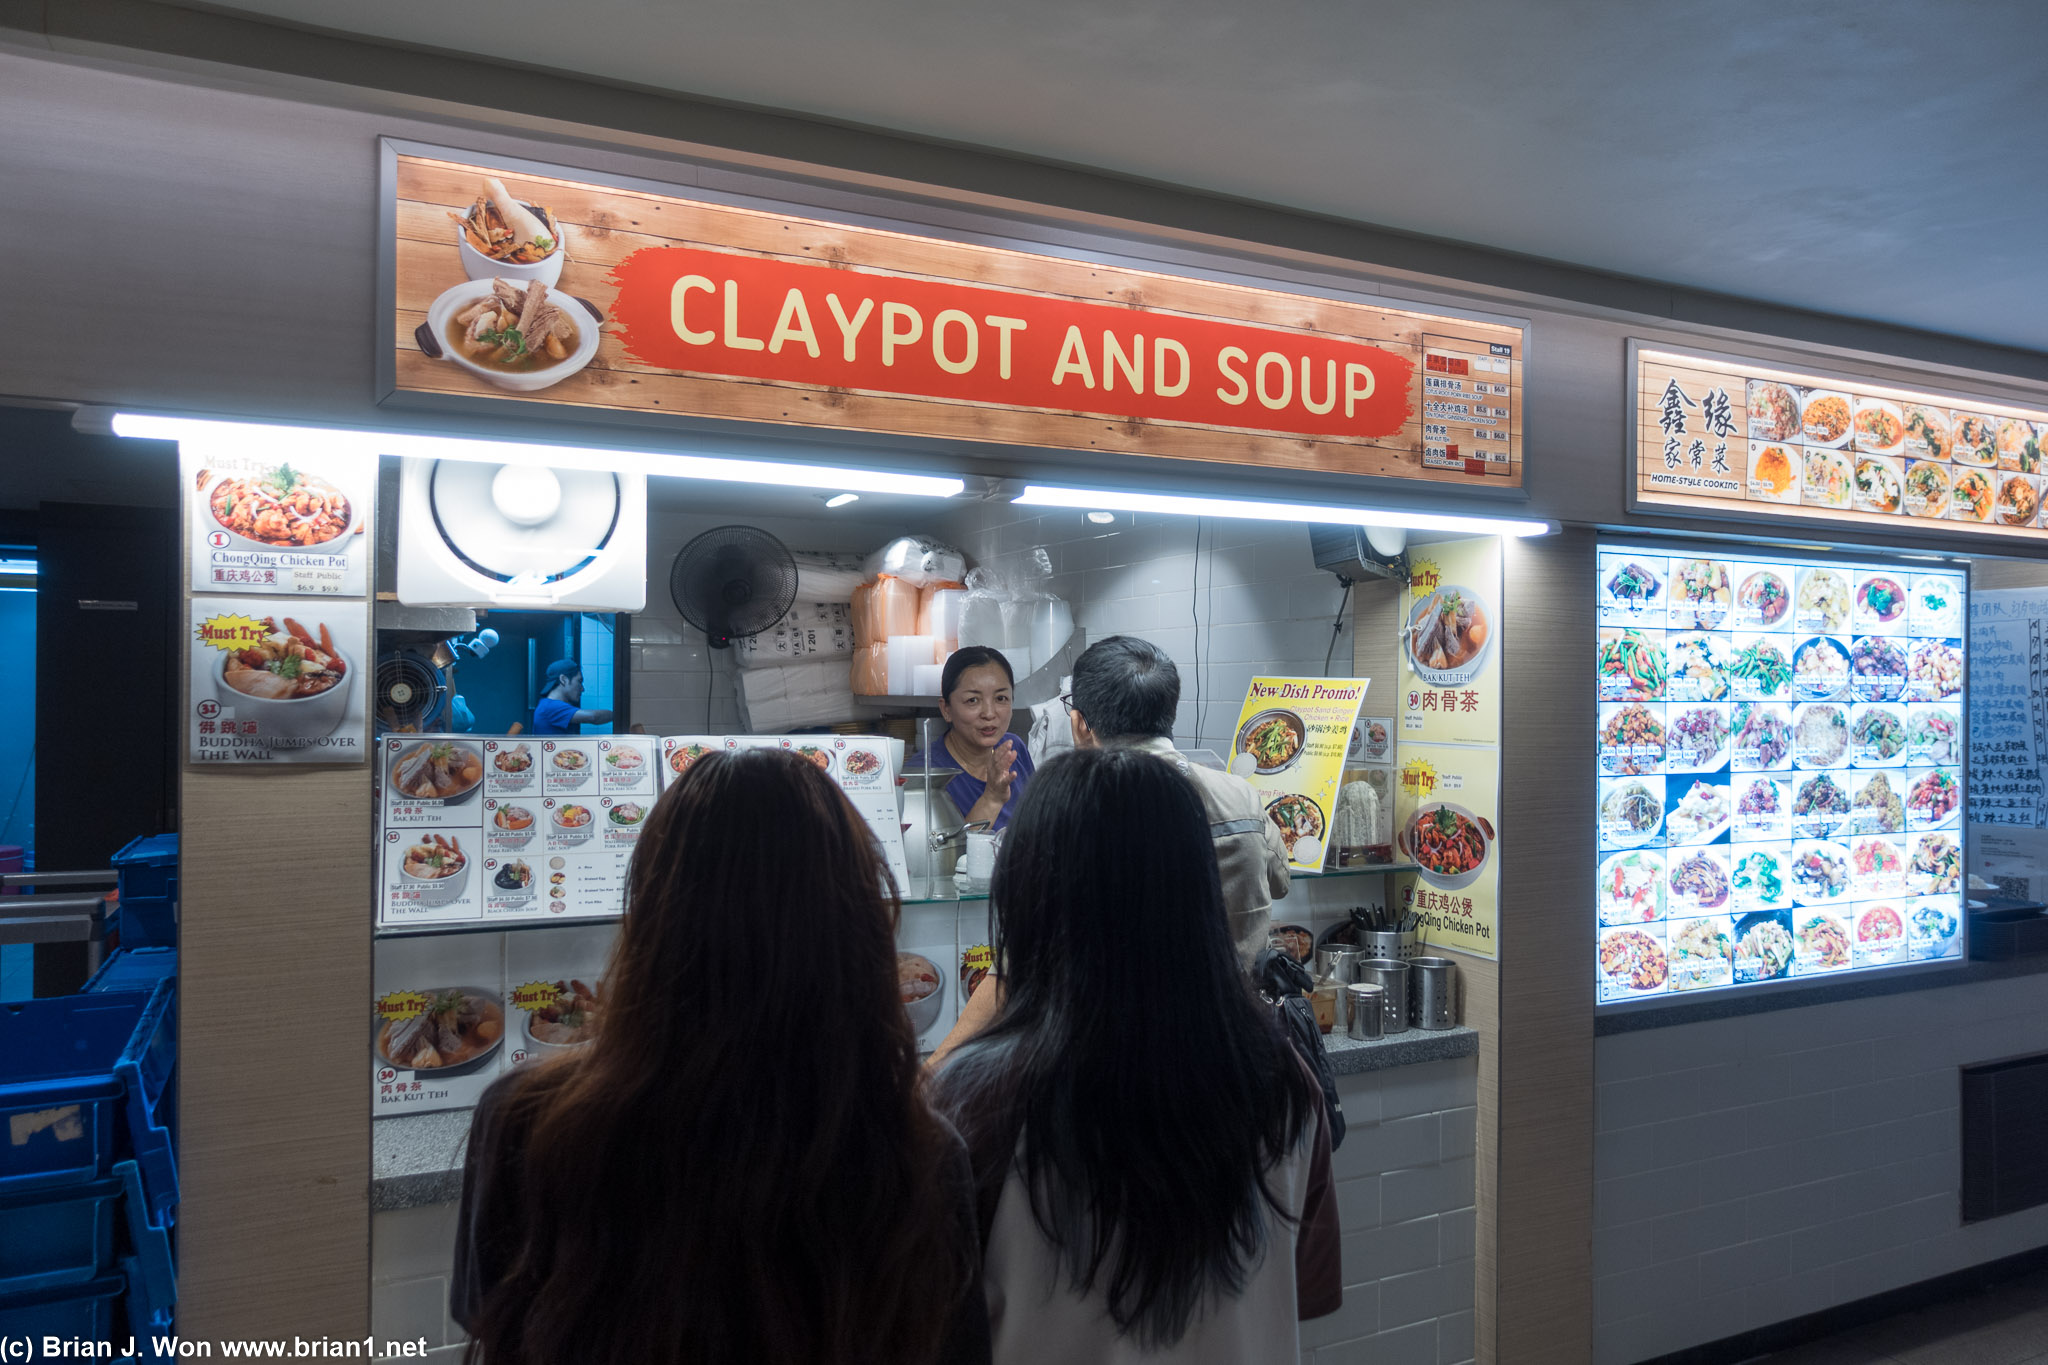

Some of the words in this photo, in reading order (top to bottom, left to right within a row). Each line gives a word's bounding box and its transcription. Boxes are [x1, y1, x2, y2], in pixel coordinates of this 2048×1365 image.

[670, 275, 1027, 380] CLAYPOT
[1052, 325, 1190, 397] AND
[1216, 345, 1375, 418] SOUP
[1425, 378, 1462, 391] 莲藕排骨汤
[1425, 401, 1468, 415] 十全大补鸡汤
[1658, 379, 1738, 439] 鑫缘
[1425, 424, 1447, 435] 肉骨茶
[204, 455, 234, 470] Must
[1664, 437, 1730, 474] 家常菜
[1651, 474, 1702, 487] HOME-STYLE
[1703, 480, 1738, 490] COOKING
[213, 534, 224, 546] 1
[212, 551, 277, 569] ChongQing
[280, 554, 324, 569] Chicken
[328, 556, 347, 569] Pot
[213, 567, 276, 584] 重庆鸡公煲
[294, 571, 314, 581] Staff
[316, 571, 342, 582] Public
[1424, 570, 1438, 589] Try
[297, 584, 315, 594] $6.9
[322, 585, 340, 595] $9.9
[202, 624, 238, 642] Must
[239, 625, 266, 645] Try
[1423, 673, 1437, 682] BAK
[1438, 673, 1453, 682] KUT
[1455, 673, 1470, 682] TEH
[1250, 682, 1279, 698] New
[1280, 683, 1310, 699] Dish
[1312, 685, 1361, 700] Promo!
[1410, 694, 1419, 707] 30
[1422, 690, 1479, 712] 肉骨茶
[201, 703, 217, 715] 31
[199, 735, 266, 748] BUDDHA
[268, 735, 312, 749] JUMPS
[316, 735, 357, 747] OVER
[836, 741, 845, 749] 10
[198, 749, 231, 761] THE
[233, 749, 275, 761] WALL
[1402, 770, 1420, 787] Must
[1421, 771, 1435, 790] Try
[393, 807, 423, 815] 肉骨茶
[1416, 889, 1473, 918] 重庆鸡公煲
[391, 907, 407, 915] THE
[1443, 915, 1474, 937] Chicken
[1476, 922, 1490, 939] Pot
[963, 952, 983, 963] Must
[513, 992, 539, 1004] Must
[540, 990, 558, 1004] Try
[377, 1001, 405, 1014] Must
[406, 1000, 426, 1014] Try
[513, 1052, 525, 1062] 31
[380, 1070, 394, 1081] 30
[380, 1082, 422, 1095] 肉骨茶
[380, 1093, 401, 1105] BAK
[403, 1092, 425, 1103] KUT
[427, 1090, 449, 1101] TEH
